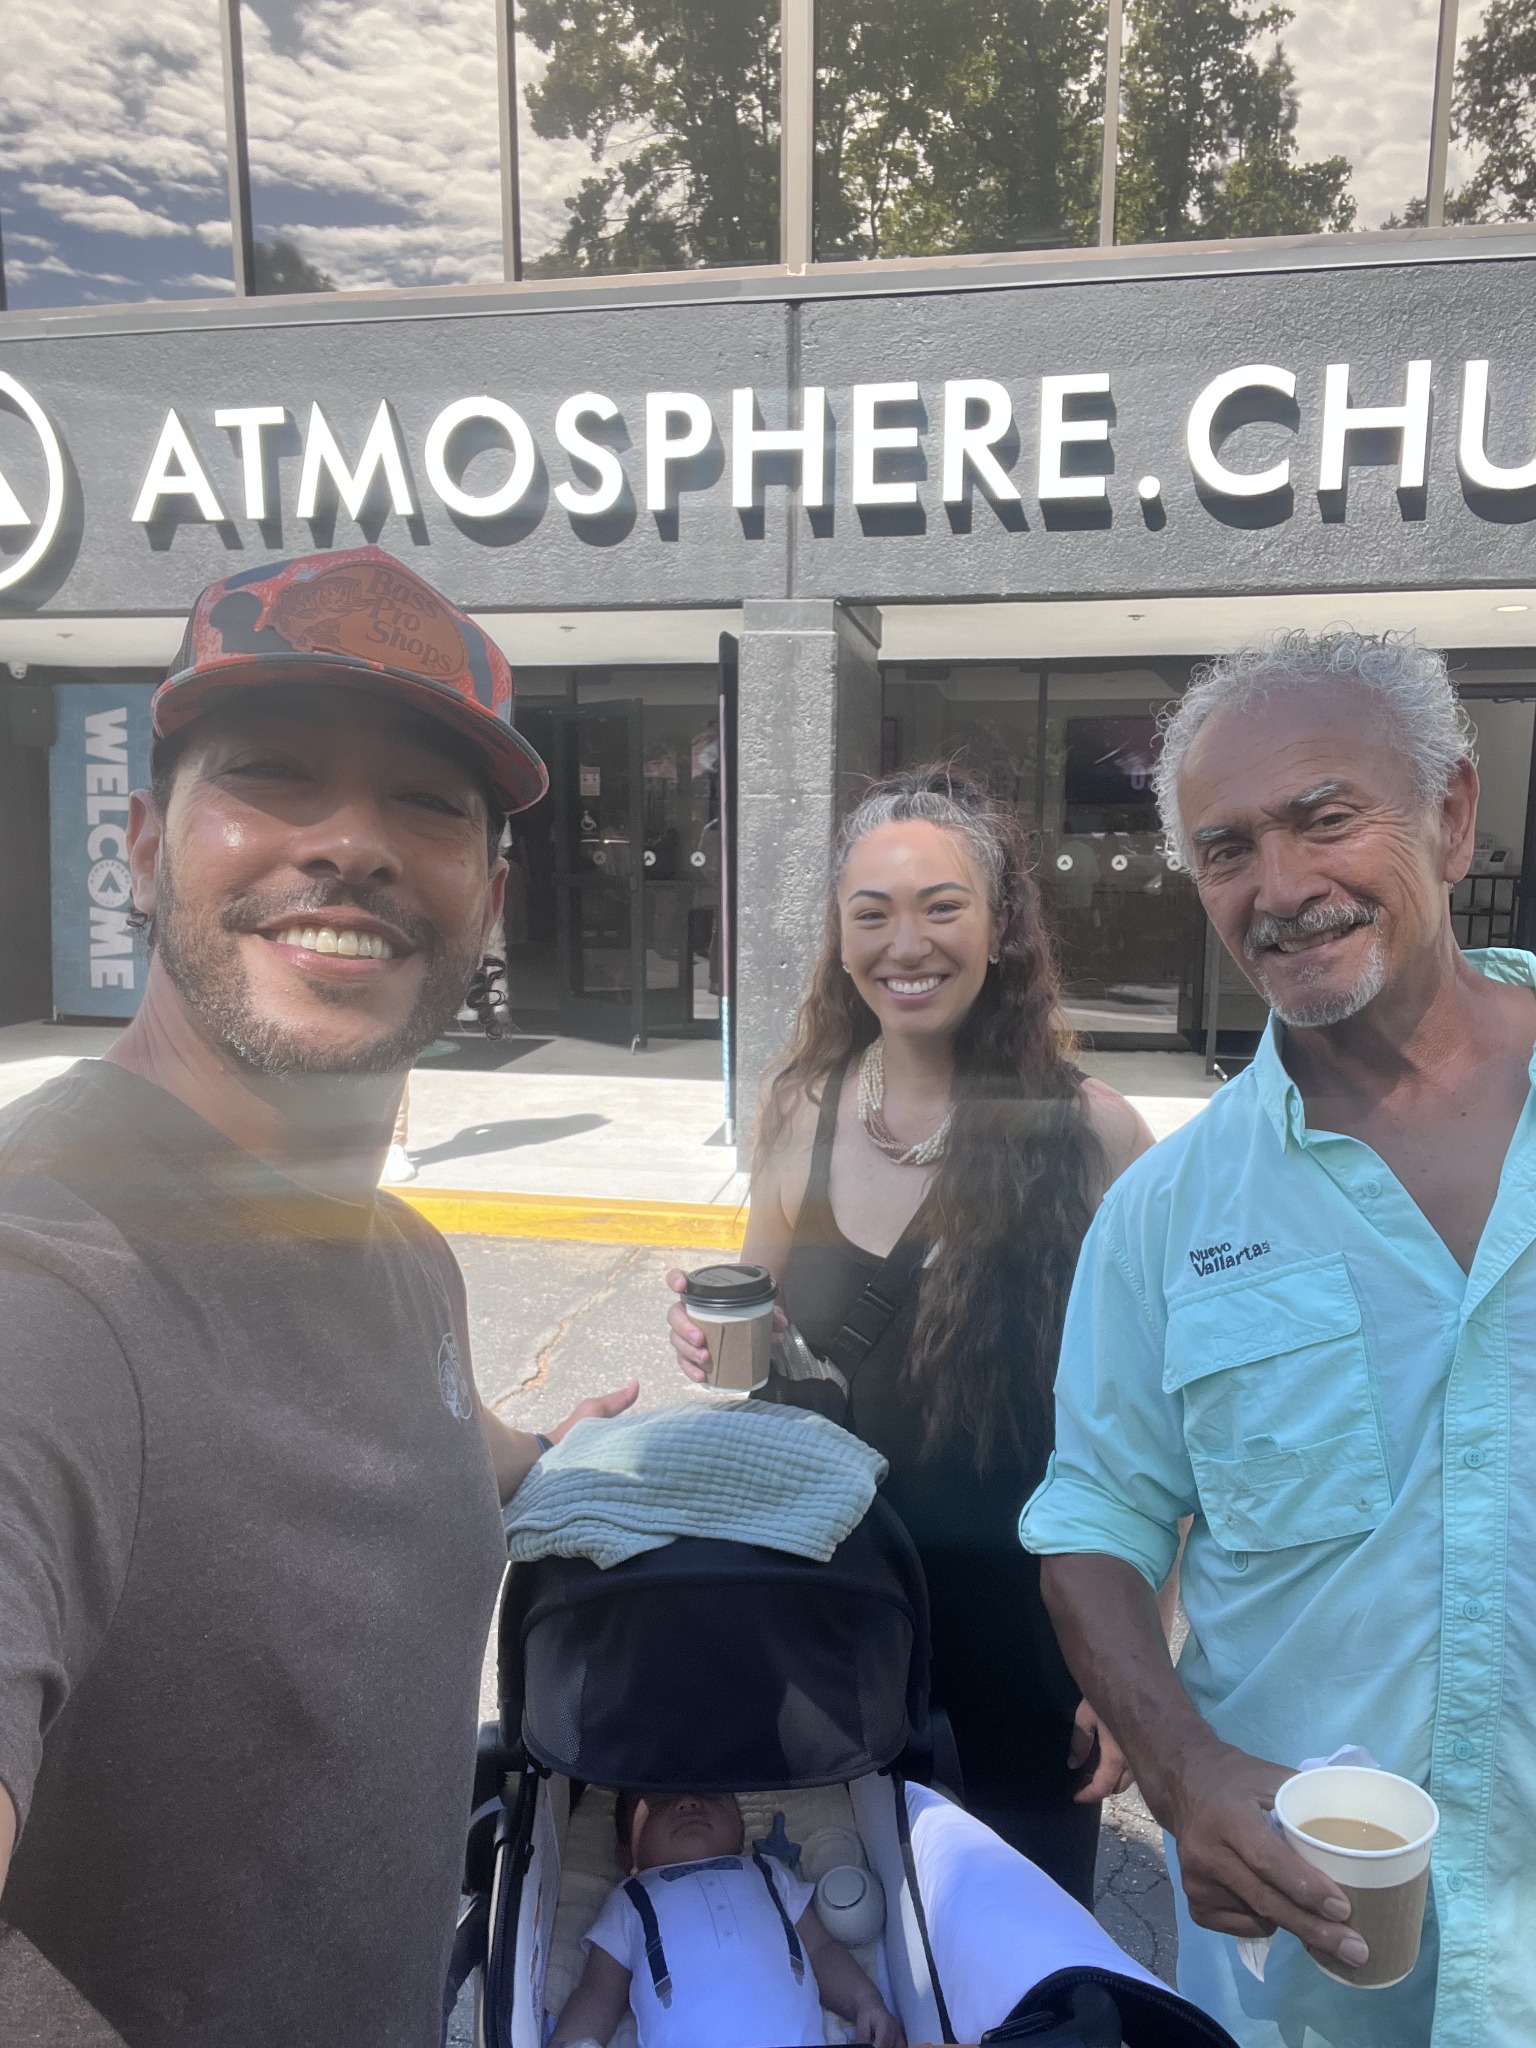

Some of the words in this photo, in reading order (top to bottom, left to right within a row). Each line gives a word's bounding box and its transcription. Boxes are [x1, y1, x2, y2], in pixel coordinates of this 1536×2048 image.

[366, 569, 441, 619] Bass
[367, 599, 422, 633] Pro
[366, 619, 453, 673] Shops
[1189, 1241, 1232, 1263] Nuevo
[1193, 1243, 1264, 1277] Vallarta
